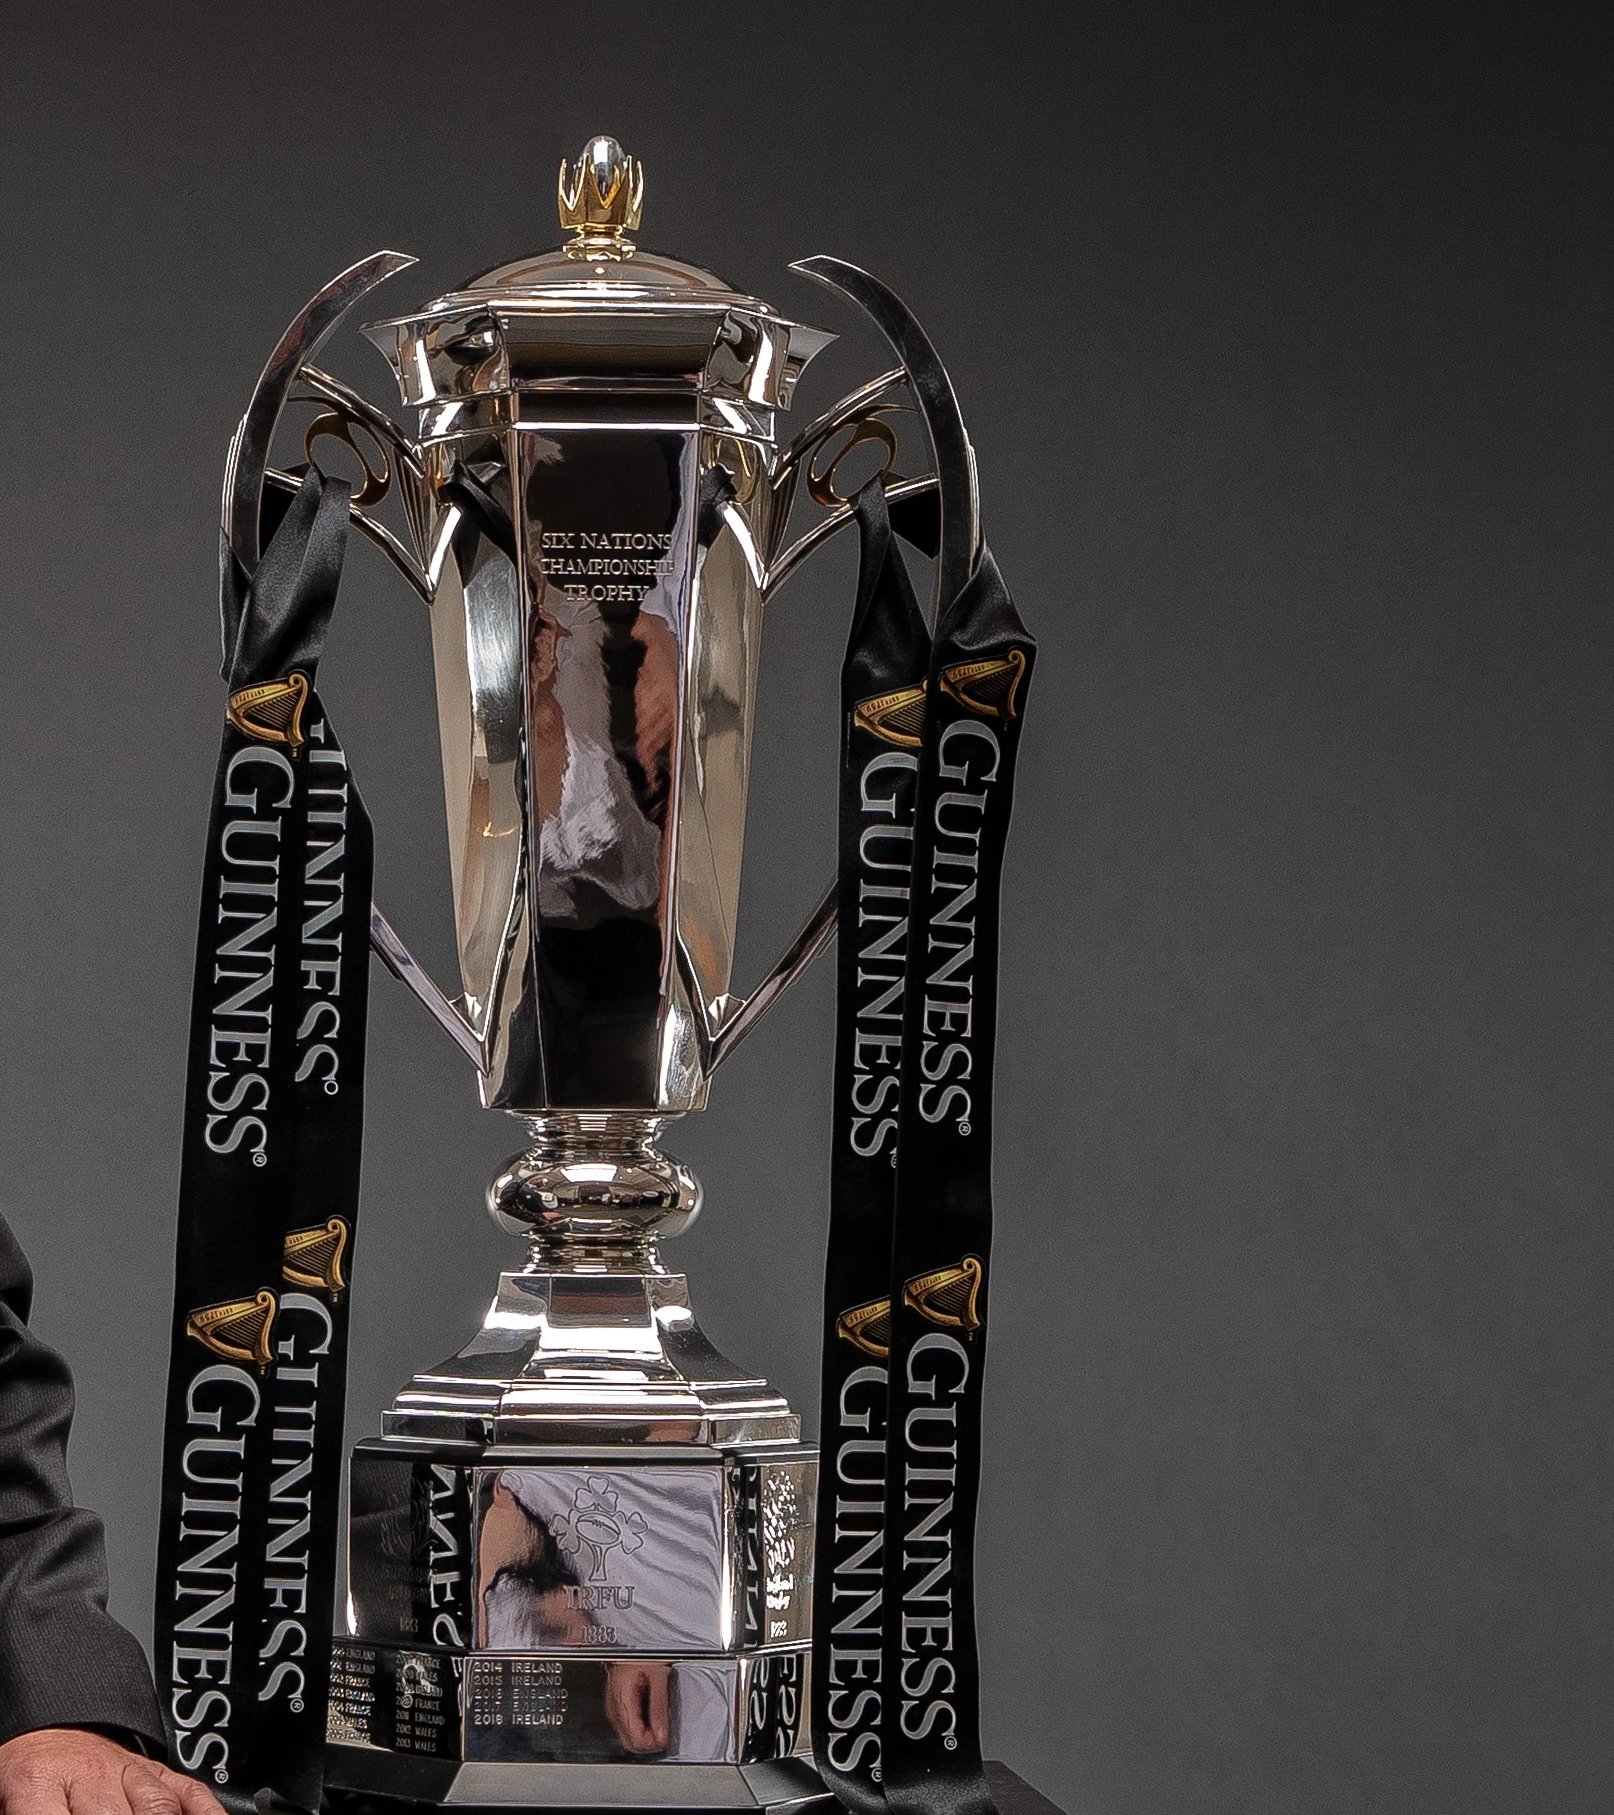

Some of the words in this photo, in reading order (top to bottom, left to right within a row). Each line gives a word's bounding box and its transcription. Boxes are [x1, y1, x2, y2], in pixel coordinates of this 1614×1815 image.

[541, 533, 574, 549] SIX
[580, 533, 672, 549] NATIONS
[539, 559, 674, 575] CHAMPIONSHIP
[564, 585, 649, 601] TROPHY
[564, 1585, 635, 1611] IRFU
[581, 1625, 618, 1644] 1883
[474, 1662, 503, 1673] 2014
[511, 1662, 563, 1673] IRELAND
[474, 1675, 503, 1686] 2015
[511, 1675, 563, 1686] IRELAND
[513, 1688, 569, 1699] ENGLAND
[474, 1714, 503, 1725] 2018
[512, 1714, 564, 1725] IRELAND
[415, 1726, 438, 1739] WALES
[415, 1740, 437, 1753] WALES
